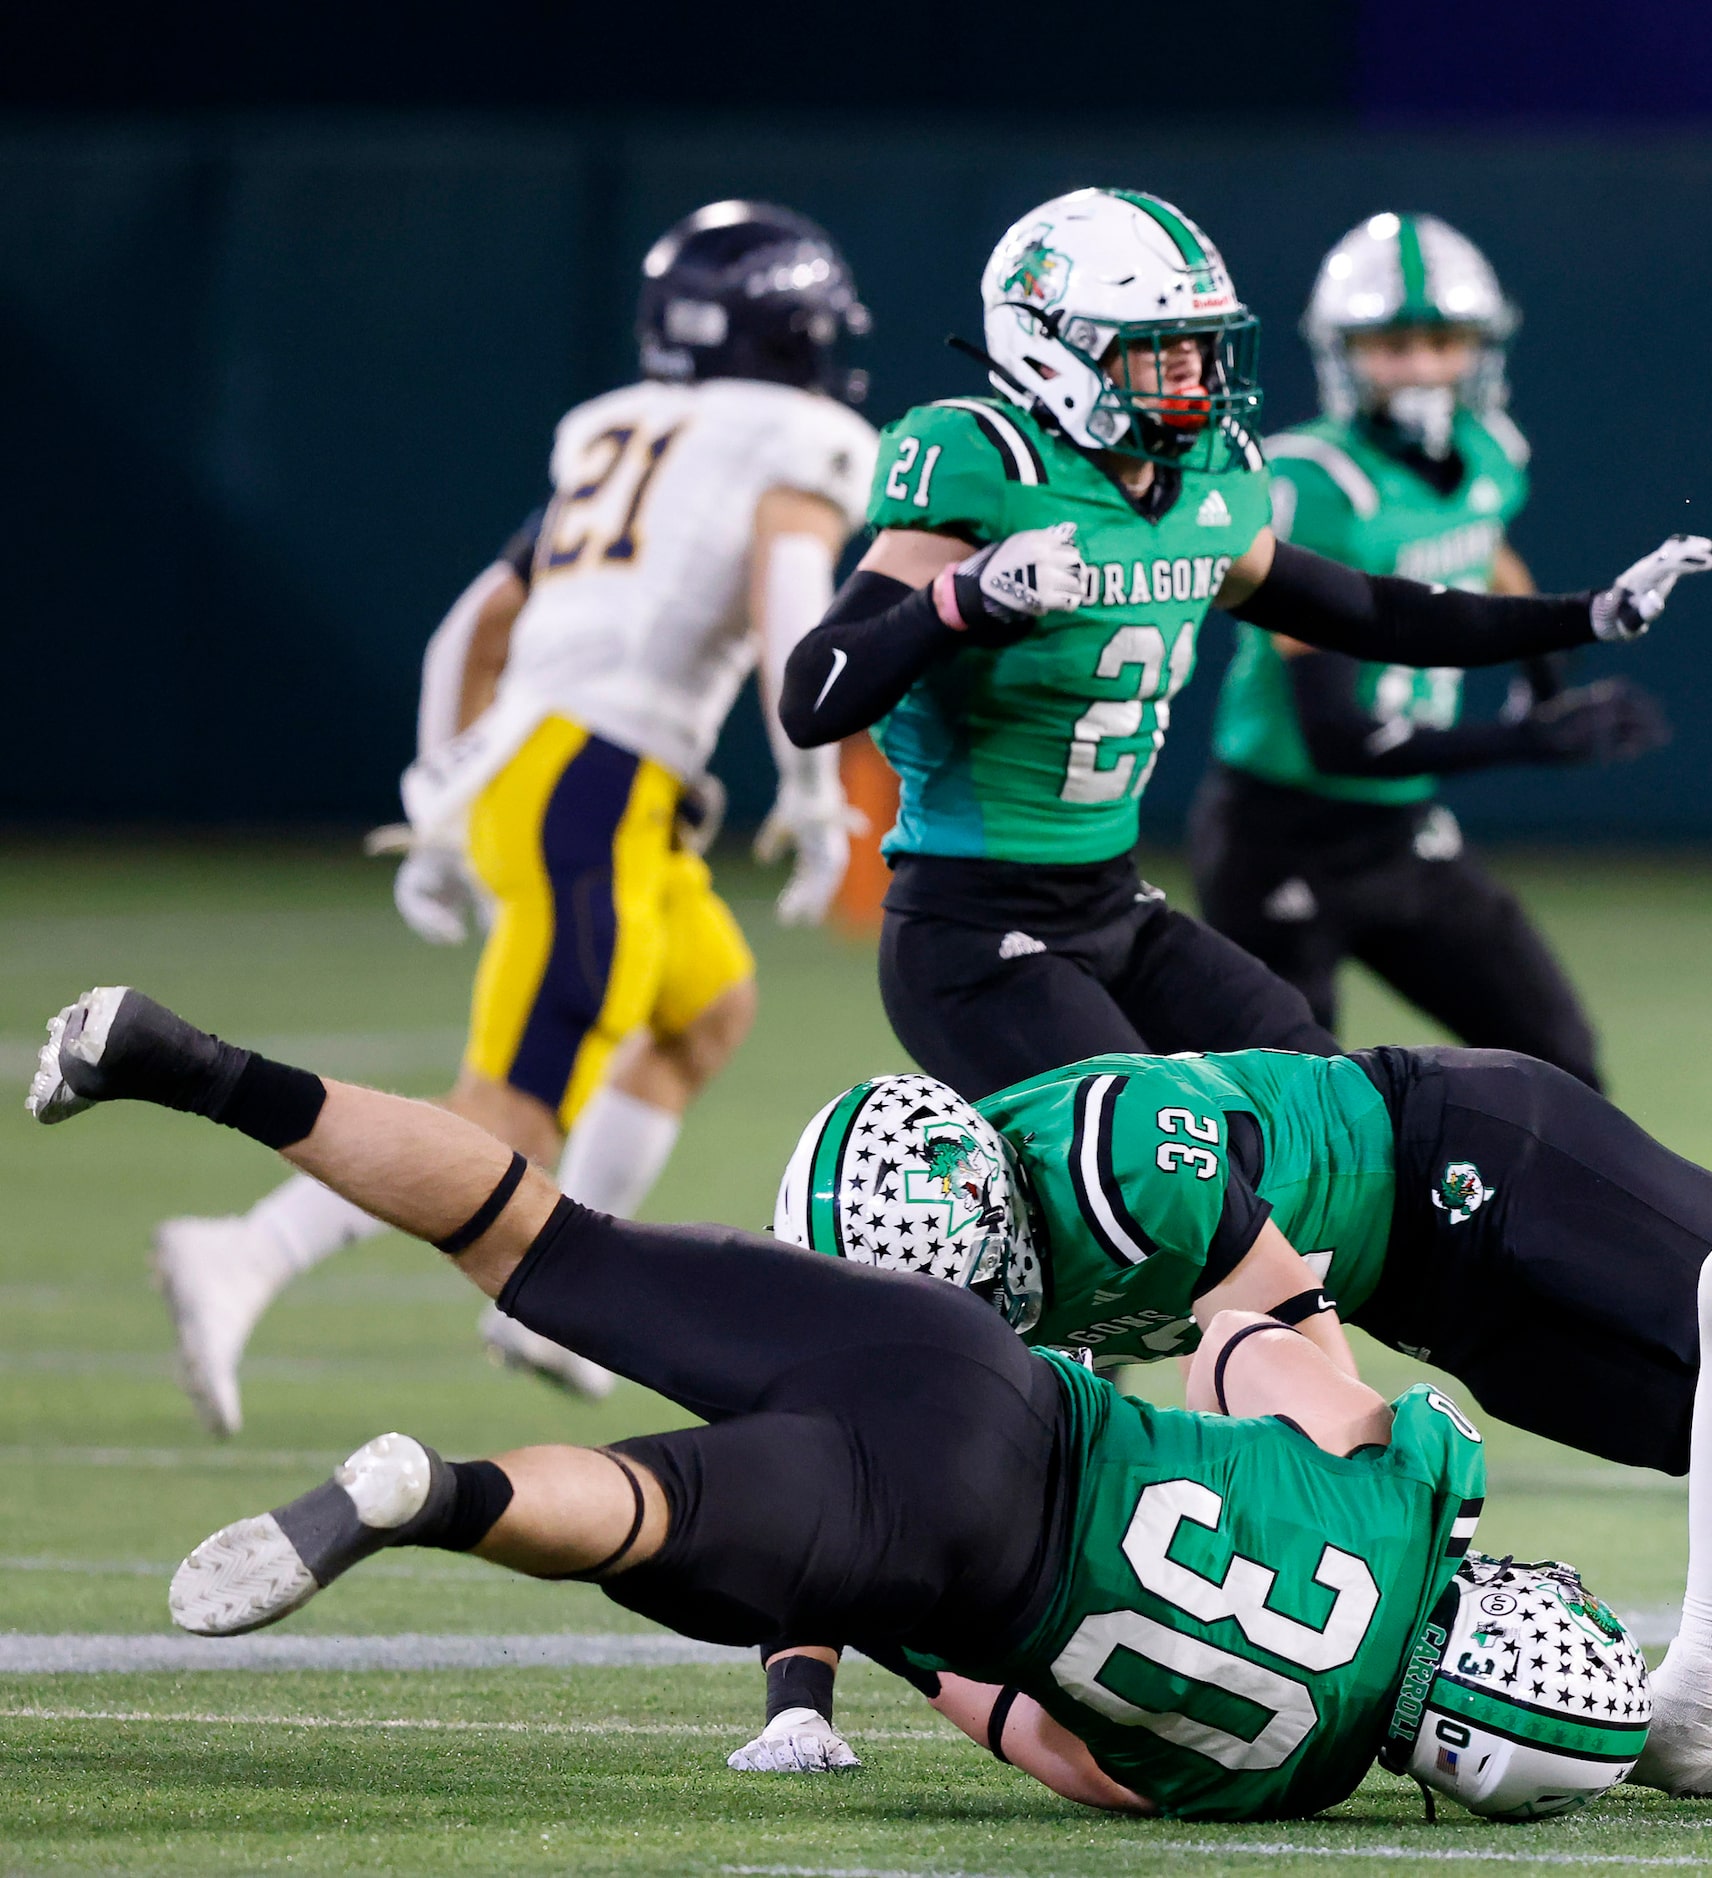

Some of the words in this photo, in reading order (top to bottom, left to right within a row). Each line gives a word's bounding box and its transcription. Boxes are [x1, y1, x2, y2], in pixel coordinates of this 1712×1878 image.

[532, 415, 690, 578] 21
[886, 436, 943, 508] 21
[1082, 555, 1232, 607] DRAGONS
[1060, 620, 1196, 801] 21
[1156, 1106, 1219, 1181] 32
[1050, 1478, 1380, 1771] 30
[1457, 1651, 1495, 1680] 3
[1387, 1623, 1447, 1742] CARROLL
